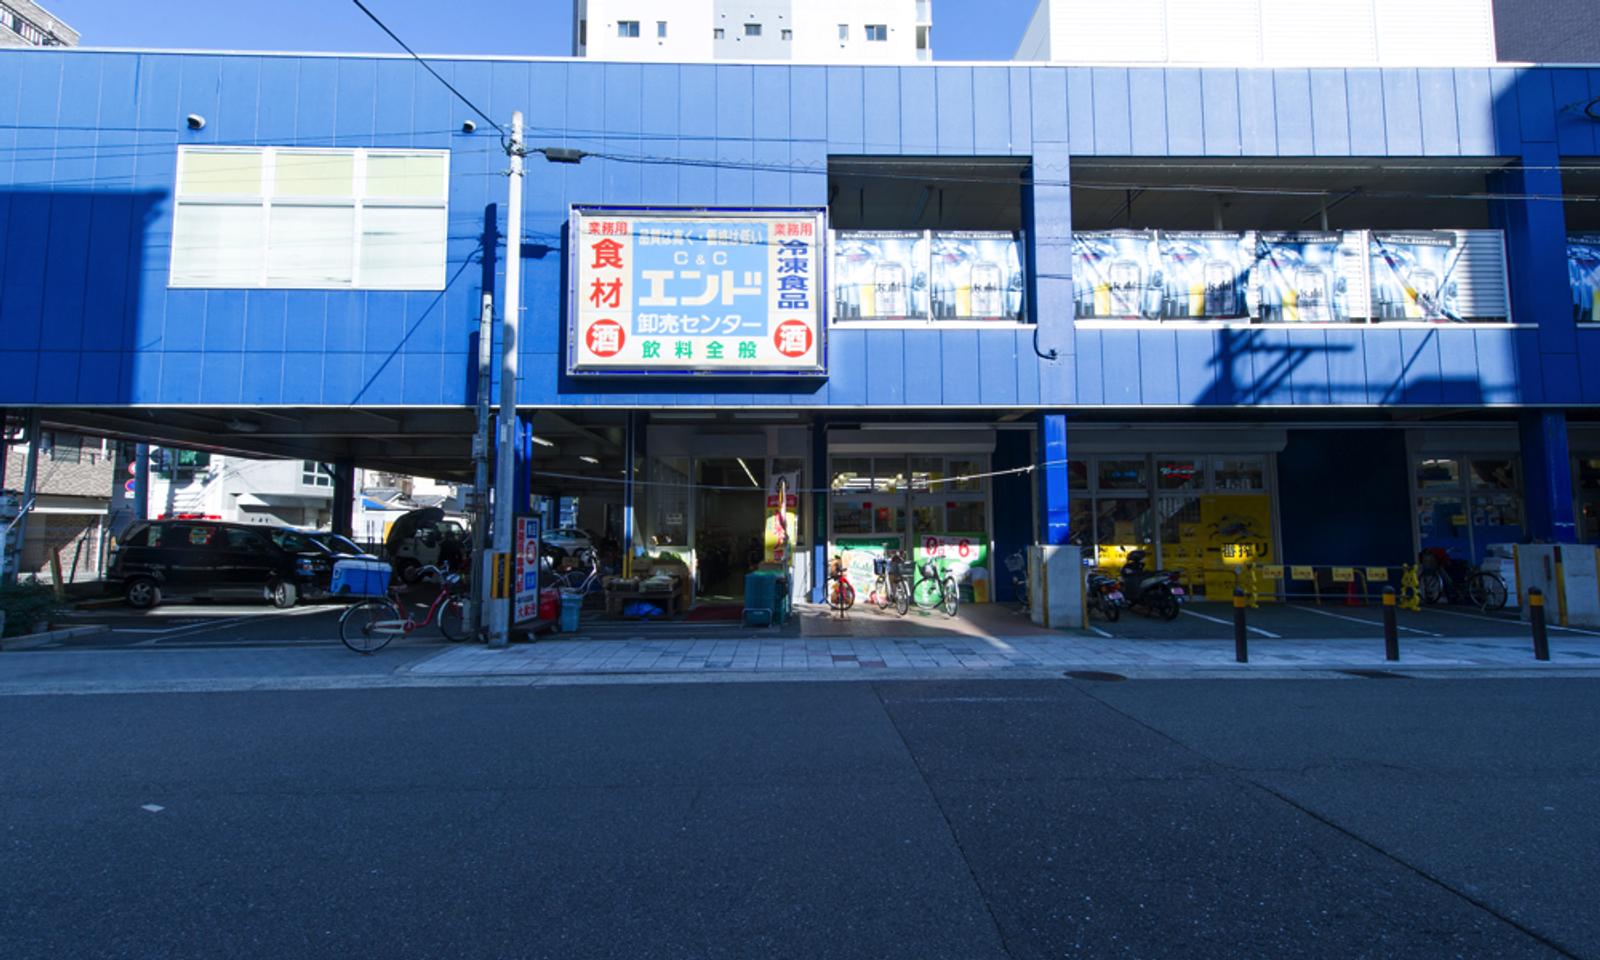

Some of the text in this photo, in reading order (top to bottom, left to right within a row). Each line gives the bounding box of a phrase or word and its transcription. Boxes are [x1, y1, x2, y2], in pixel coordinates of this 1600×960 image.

[588, 222, 628, 235] 業務用
[773, 223, 813, 236] 業務用
[673, 251, 689, 265] C
[712, 251, 728, 265] C
[589, 238, 624, 308] 食材
[777, 239, 809, 309] 冷凍食品
[639, 270, 762, 306] エンド
[637, 313, 762, 334] 卸売センター
[591, 324, 621, 352] 酒
[641, 340, 758, 359] 飲料全般
[778, 324, 808, 353] 酒
